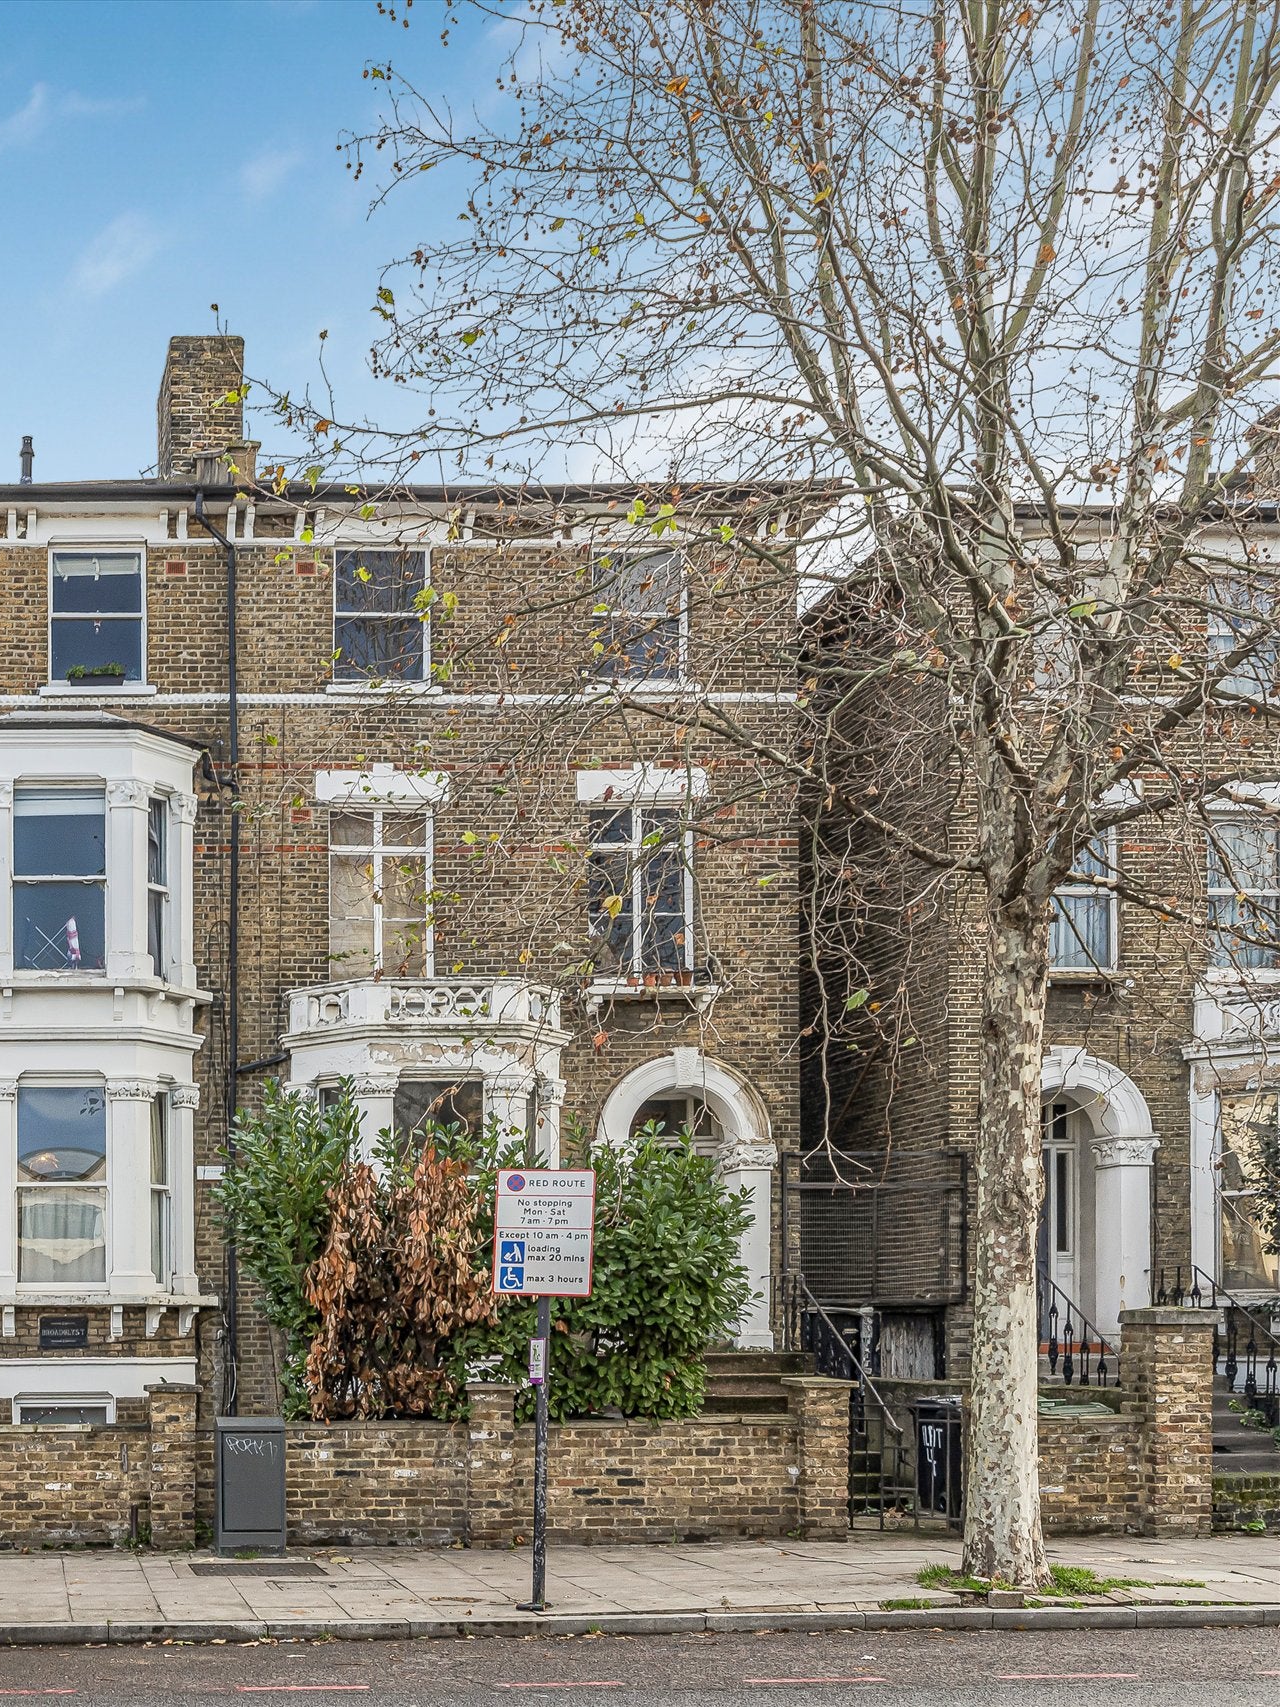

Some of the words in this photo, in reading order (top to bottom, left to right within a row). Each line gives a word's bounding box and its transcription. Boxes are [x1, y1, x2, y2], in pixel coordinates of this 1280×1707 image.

[529, 1179, 549, 1187] RED
[552, 1179, 586, 1188] ROUTE
[517, 1199, 531, 1207] No
[533, 1199, 573, 1208] stopping
[523, 1208, 543, 1216] Mon
[550, 1208, 566, 1216] Sat
[499, 1231, 530, 1240] Except
[527, 1245, 561, 1254] loading
[549, 1254, 561, 1262] 20
[563, 1254, 585, 1262] mins
[557, 1275, 584, 1284] hours
